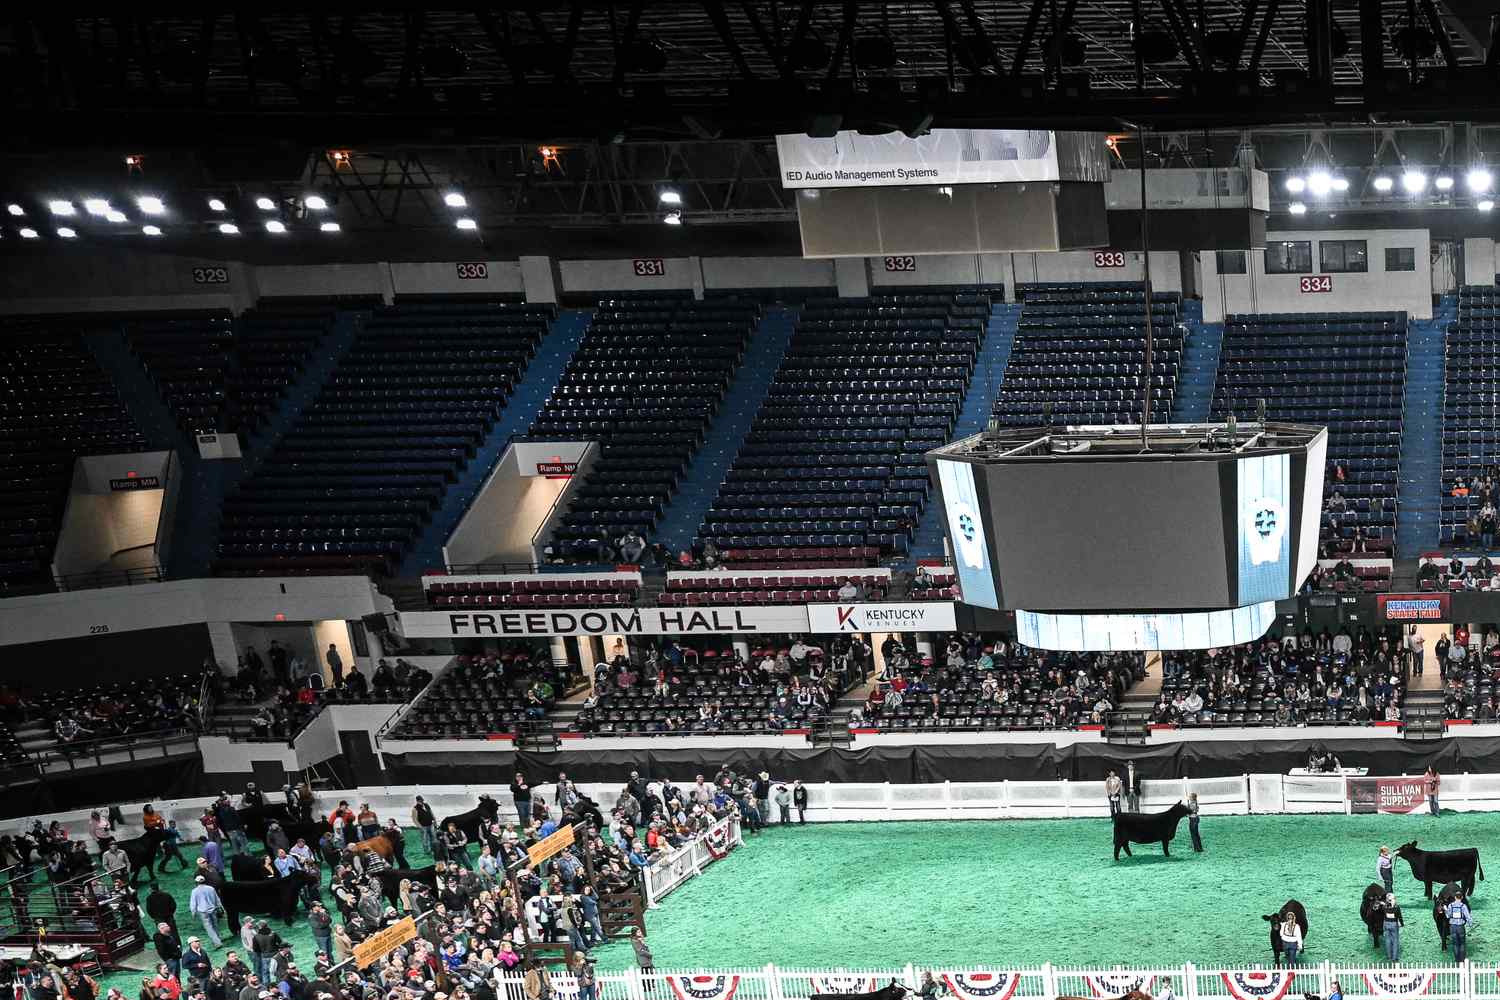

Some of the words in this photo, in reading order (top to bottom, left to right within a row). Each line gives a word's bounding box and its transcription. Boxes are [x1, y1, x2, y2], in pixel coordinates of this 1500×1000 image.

[786, 171, 803, 181] IED
[804, 170, 833, 181] Audio
[834, 168, 895, 182] Management
[897, 167, 938, 179] Systems
[636, 259, 664, 275] 331
[886, 256, 915, 271] 332
[1096, 252, 1125, 267] 333
[194, 267, 228, 283] 329
[458, 263, 487, 278] 330
[1302, 277, 1331, 292] 334
[539, 465, 562, 474] Ramp
[112, 479, 139, 489] Ramp
[1386, 600, 1441, 610] KENTUCKY
[866, 609, 925, 620] KENTUCKY
[1386, 609, 1418, 619] STATE
[449, 611, 644, 634] FREEDOM
[659, 610, 757, 632] HALL
[1380, 784, 1421, 796] SULLIVAN
[1381, 796, 1413, 806] SUPPLY
